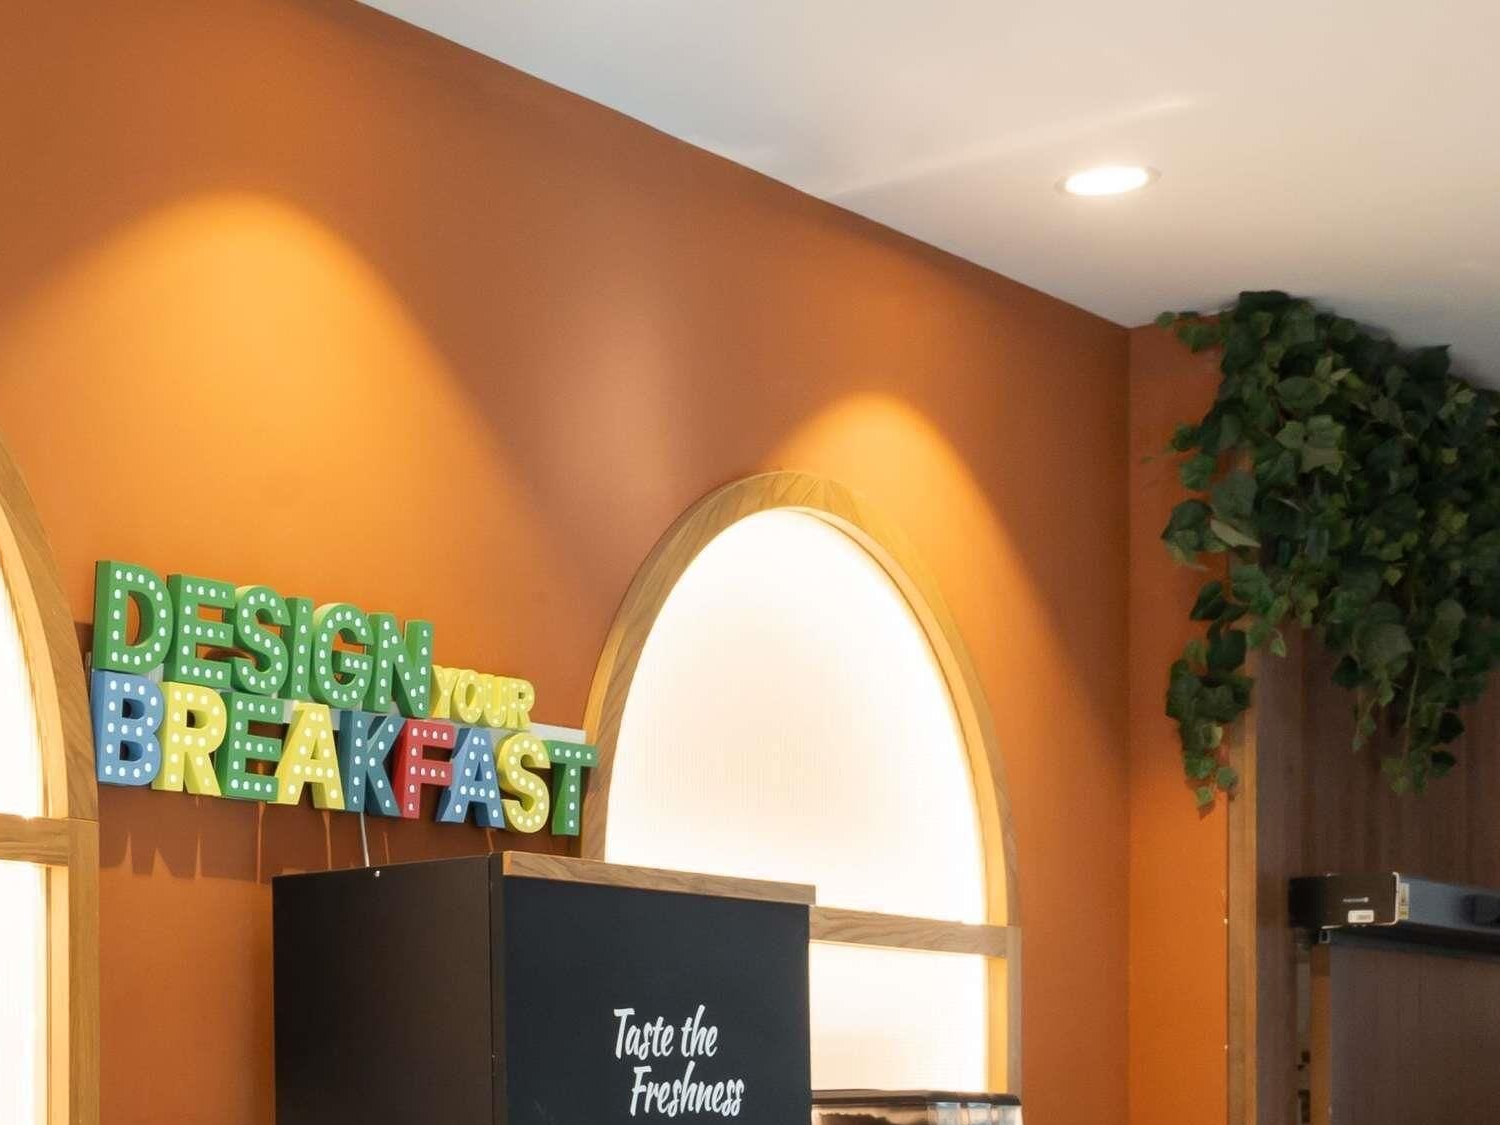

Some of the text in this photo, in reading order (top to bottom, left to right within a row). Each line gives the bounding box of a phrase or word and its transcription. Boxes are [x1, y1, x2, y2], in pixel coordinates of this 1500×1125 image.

[93, 560, 536, 729] DESIGN YOUR
[92, 668, 598, 836] BREAKFAST
[613, 1004, 718, 1061] Taste the
[629, 1060, 745, 1118] Freshness
